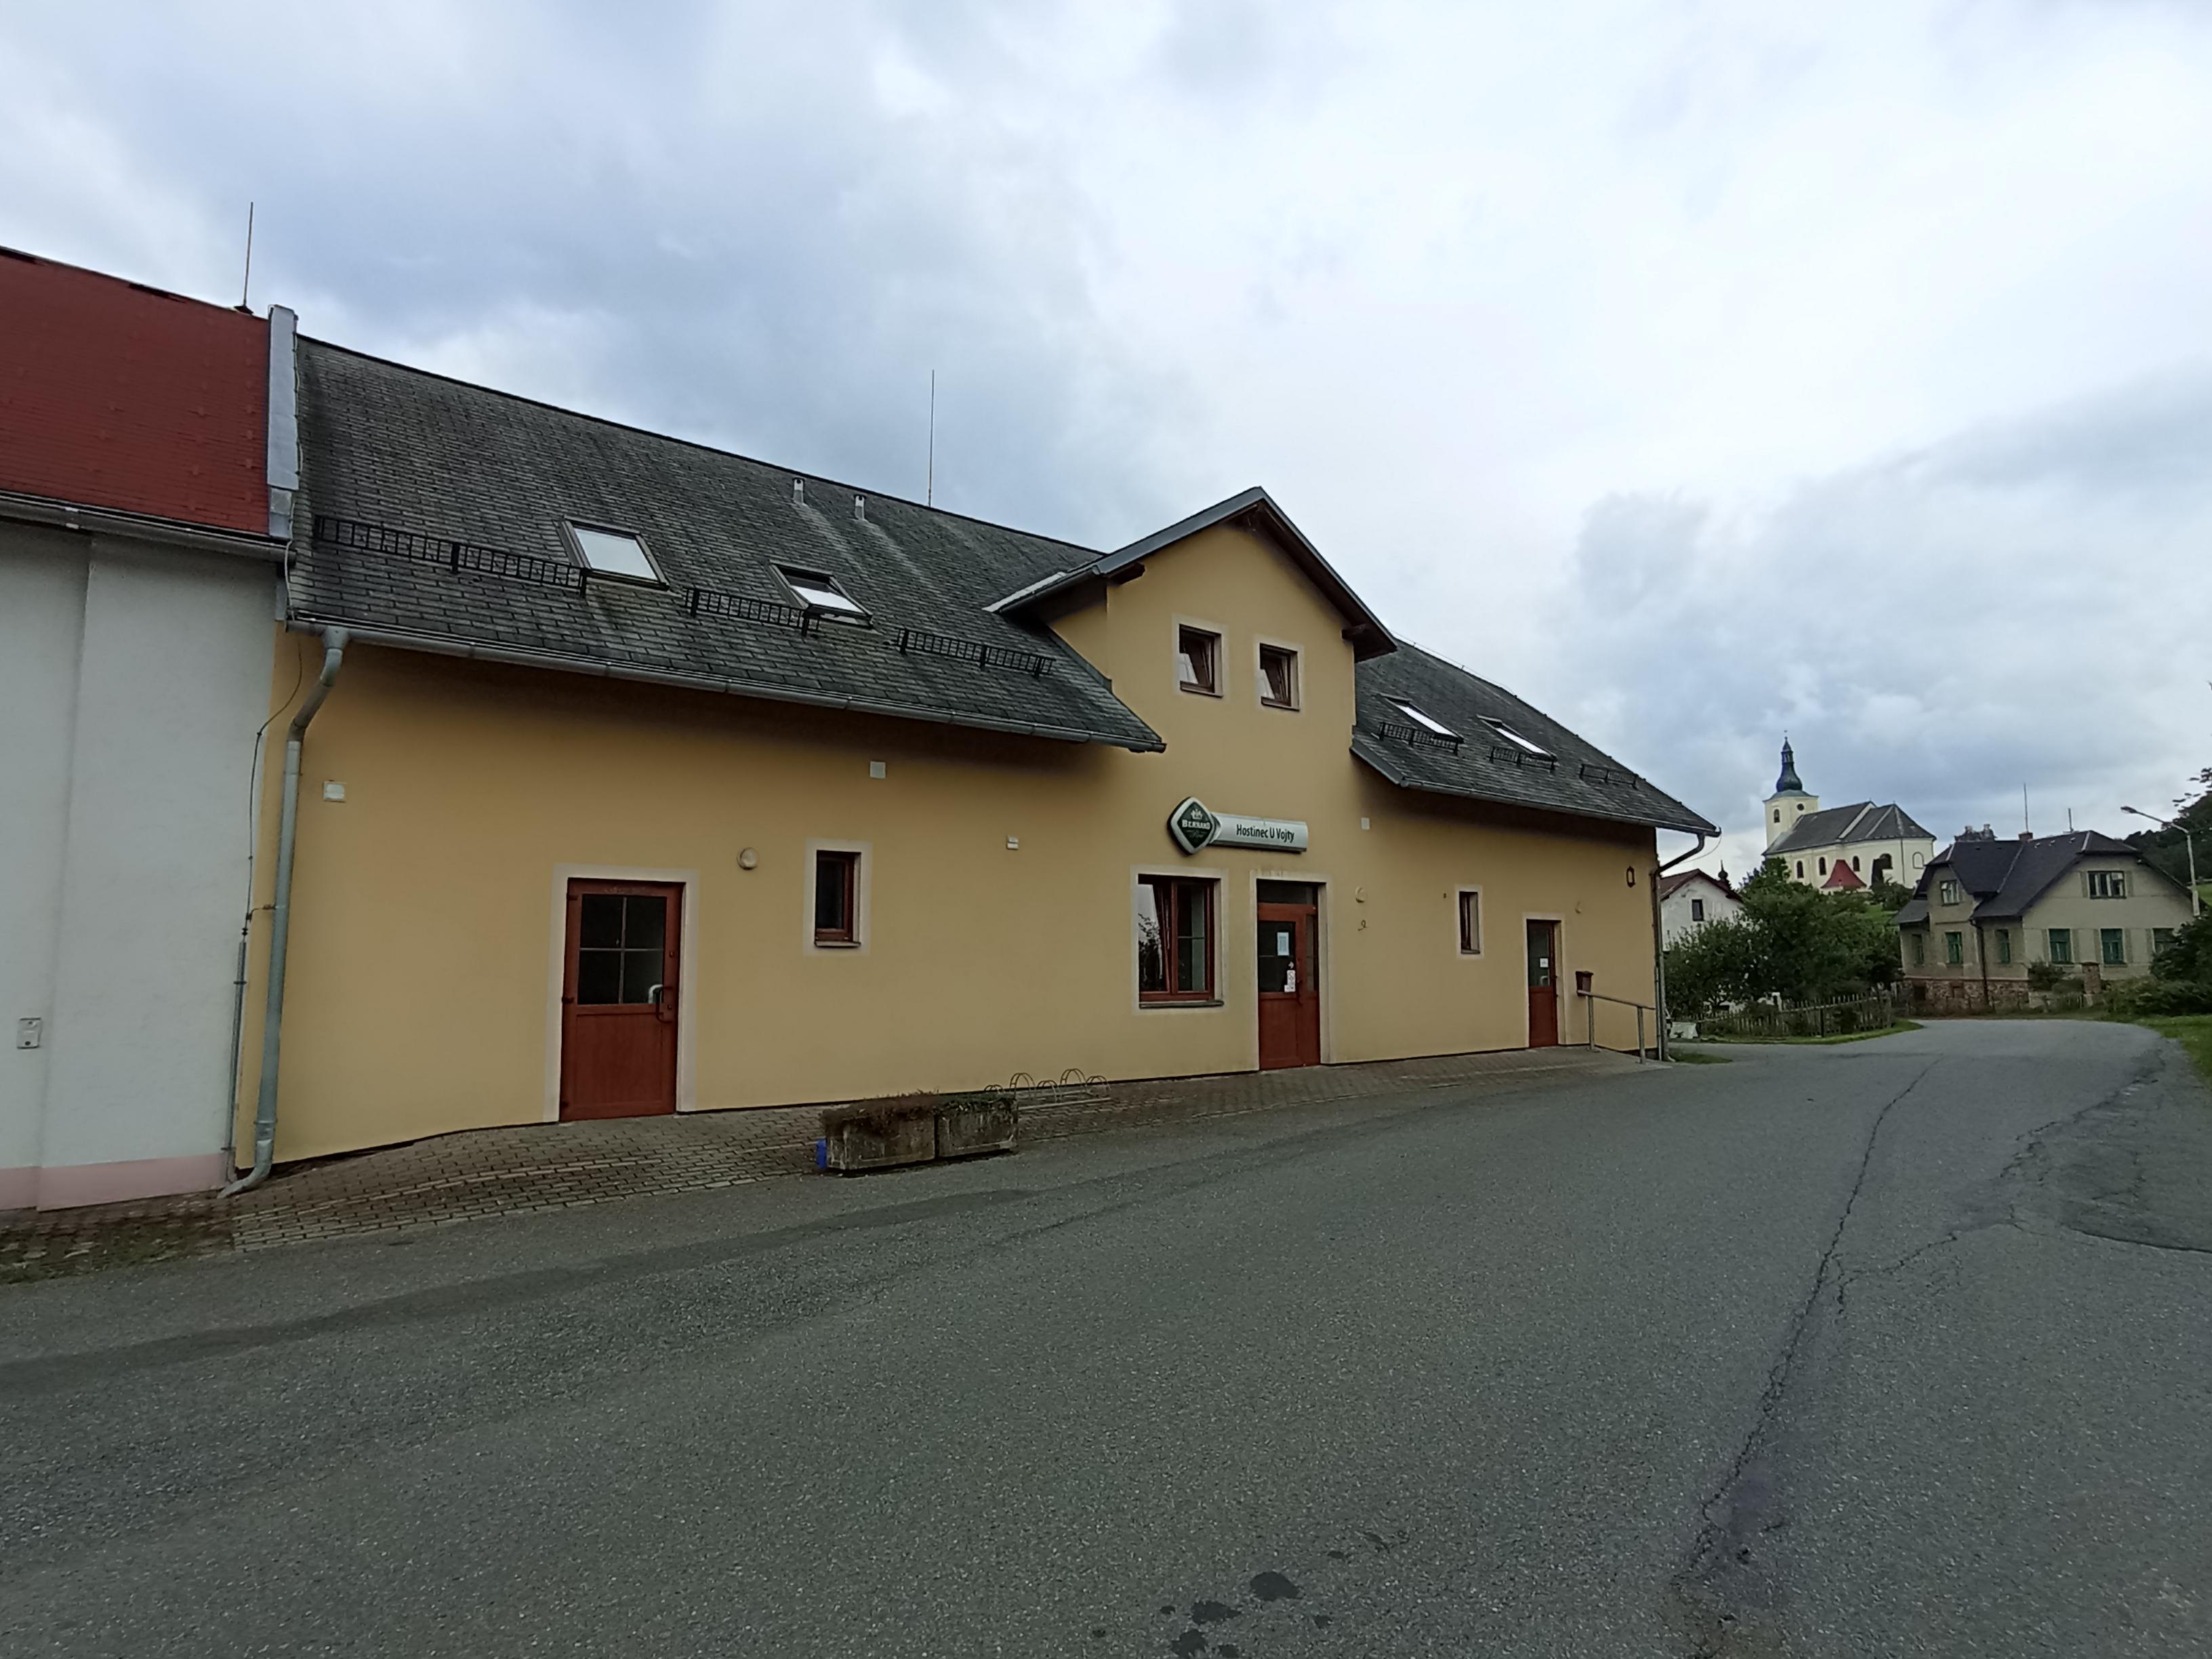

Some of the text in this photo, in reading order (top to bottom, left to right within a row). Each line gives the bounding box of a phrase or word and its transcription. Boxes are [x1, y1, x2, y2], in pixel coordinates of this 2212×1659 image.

[1236, 823, 1294, 843] Hostinec U Vojty
